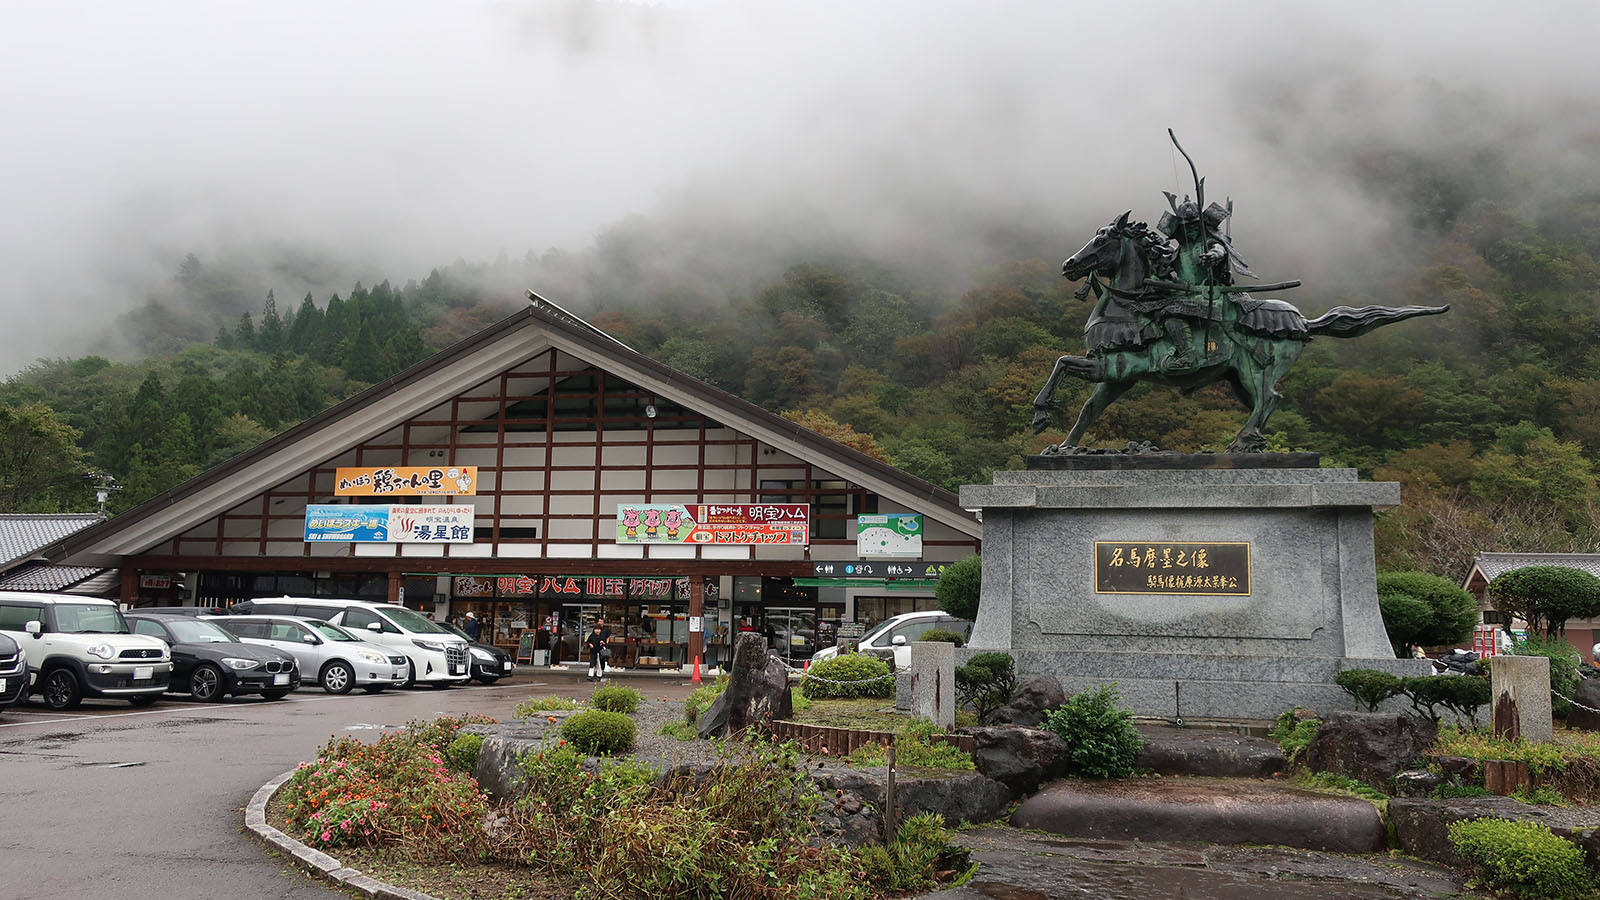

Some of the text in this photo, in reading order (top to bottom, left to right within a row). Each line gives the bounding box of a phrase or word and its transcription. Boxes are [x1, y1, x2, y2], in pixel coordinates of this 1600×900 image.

[749, 505, 806, 521] 明宝ハム
[413, 525, 471, 541] 湯星館
[714, 530, 788, 543] トマトケチャップ
